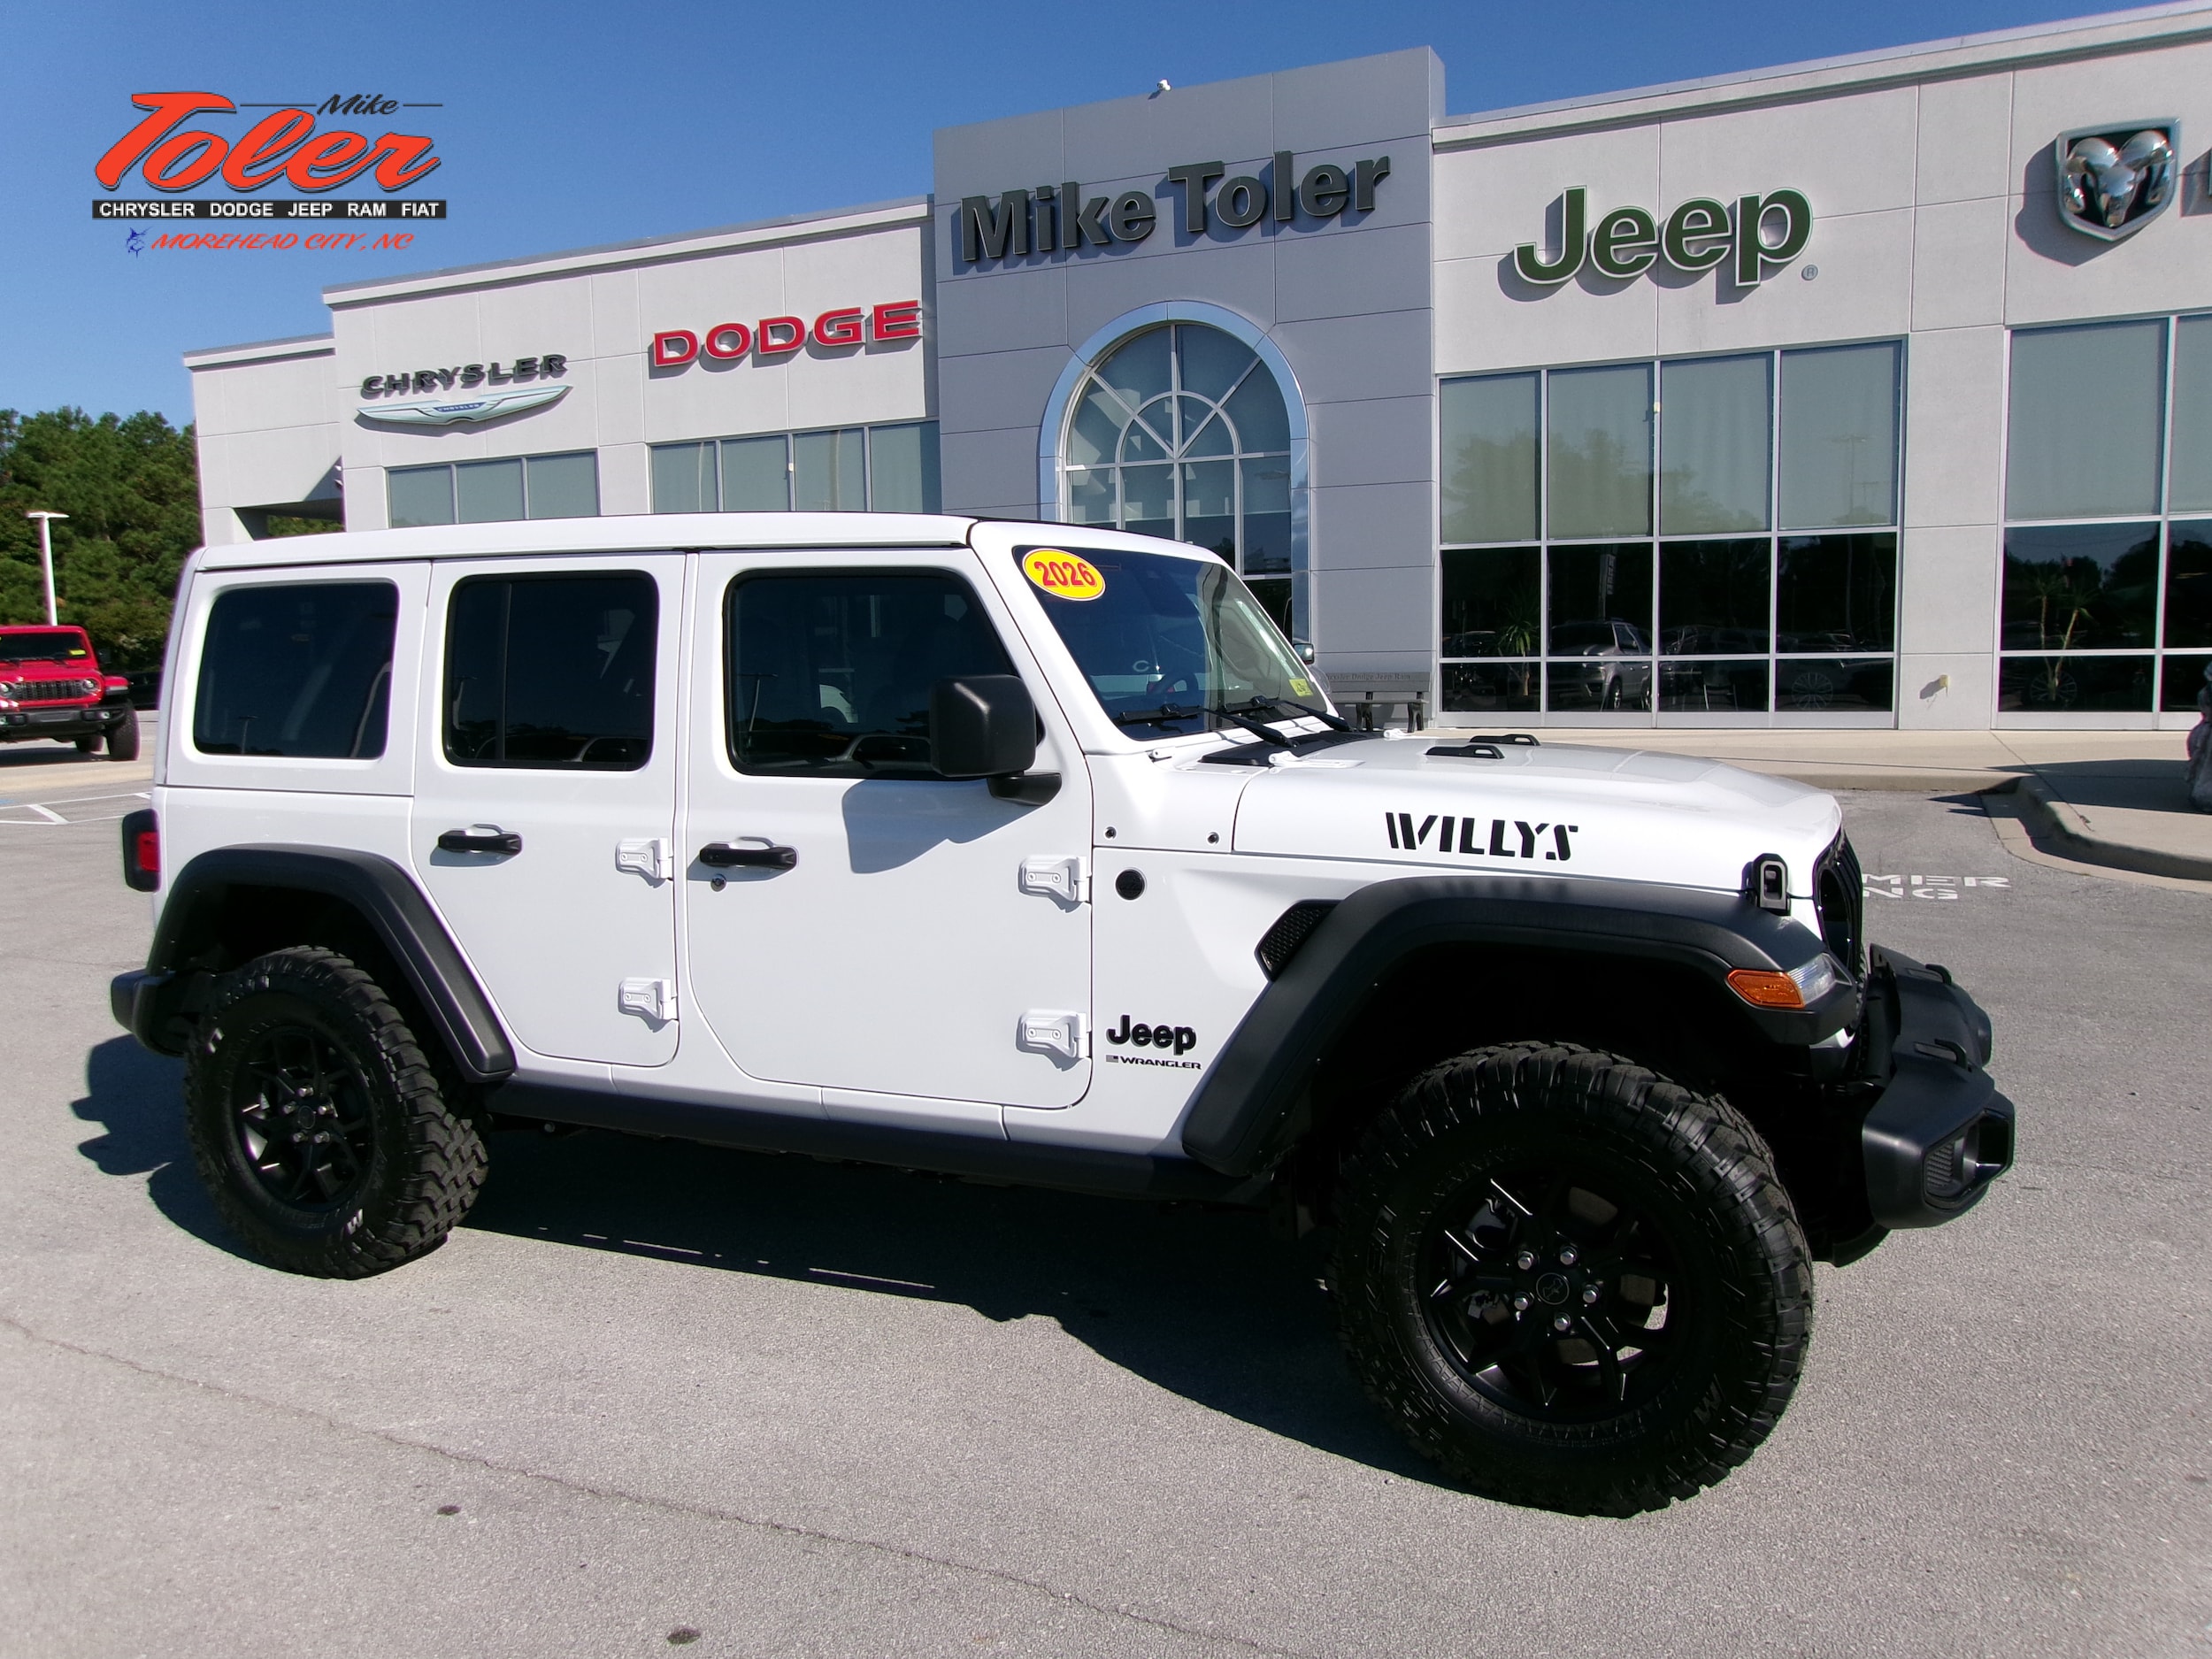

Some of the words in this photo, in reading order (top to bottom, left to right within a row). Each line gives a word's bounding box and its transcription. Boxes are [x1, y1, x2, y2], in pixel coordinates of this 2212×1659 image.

[961, 181, 1156, 262] Mike
[1168, 150, 1391, 234] Toler
[1514, 185, 1814, 287] Jeep
[652, 298, 921, 368] DODGE
[362, 353, 568, 395] CHRYSLER
[1033, 560, 1098, 588] 2026
[1385, 811, 1579, 861] WILLYS
[1106, 1014, 1197, 1056] Jeep
[1120, 1056, 1202, 1071] WRANGLER
